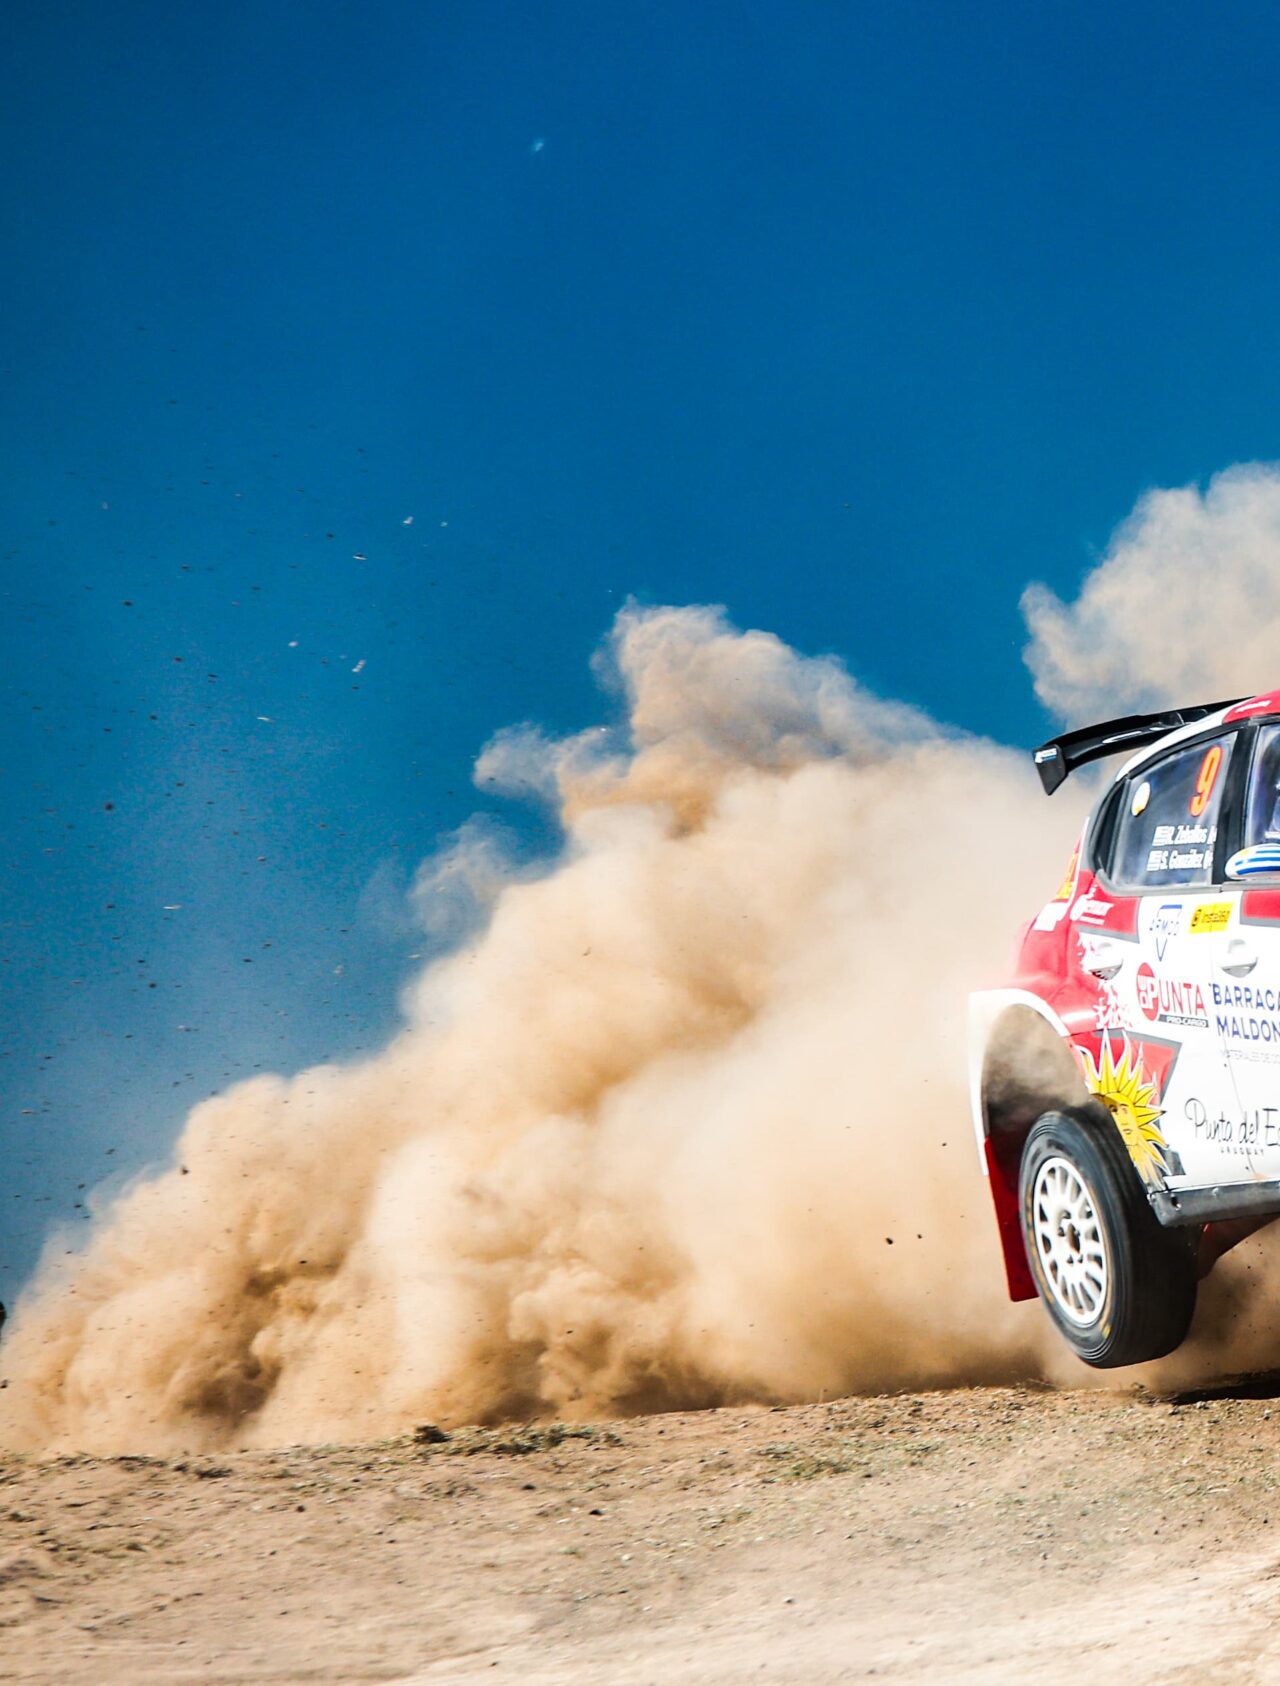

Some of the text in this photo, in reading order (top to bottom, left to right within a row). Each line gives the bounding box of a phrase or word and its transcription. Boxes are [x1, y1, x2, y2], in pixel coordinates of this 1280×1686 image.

[1188, 745, 1223, 817] 9
[1184, 1097, 1232, 1142] Punta
[1238, 1110, 1259, 1144] del
